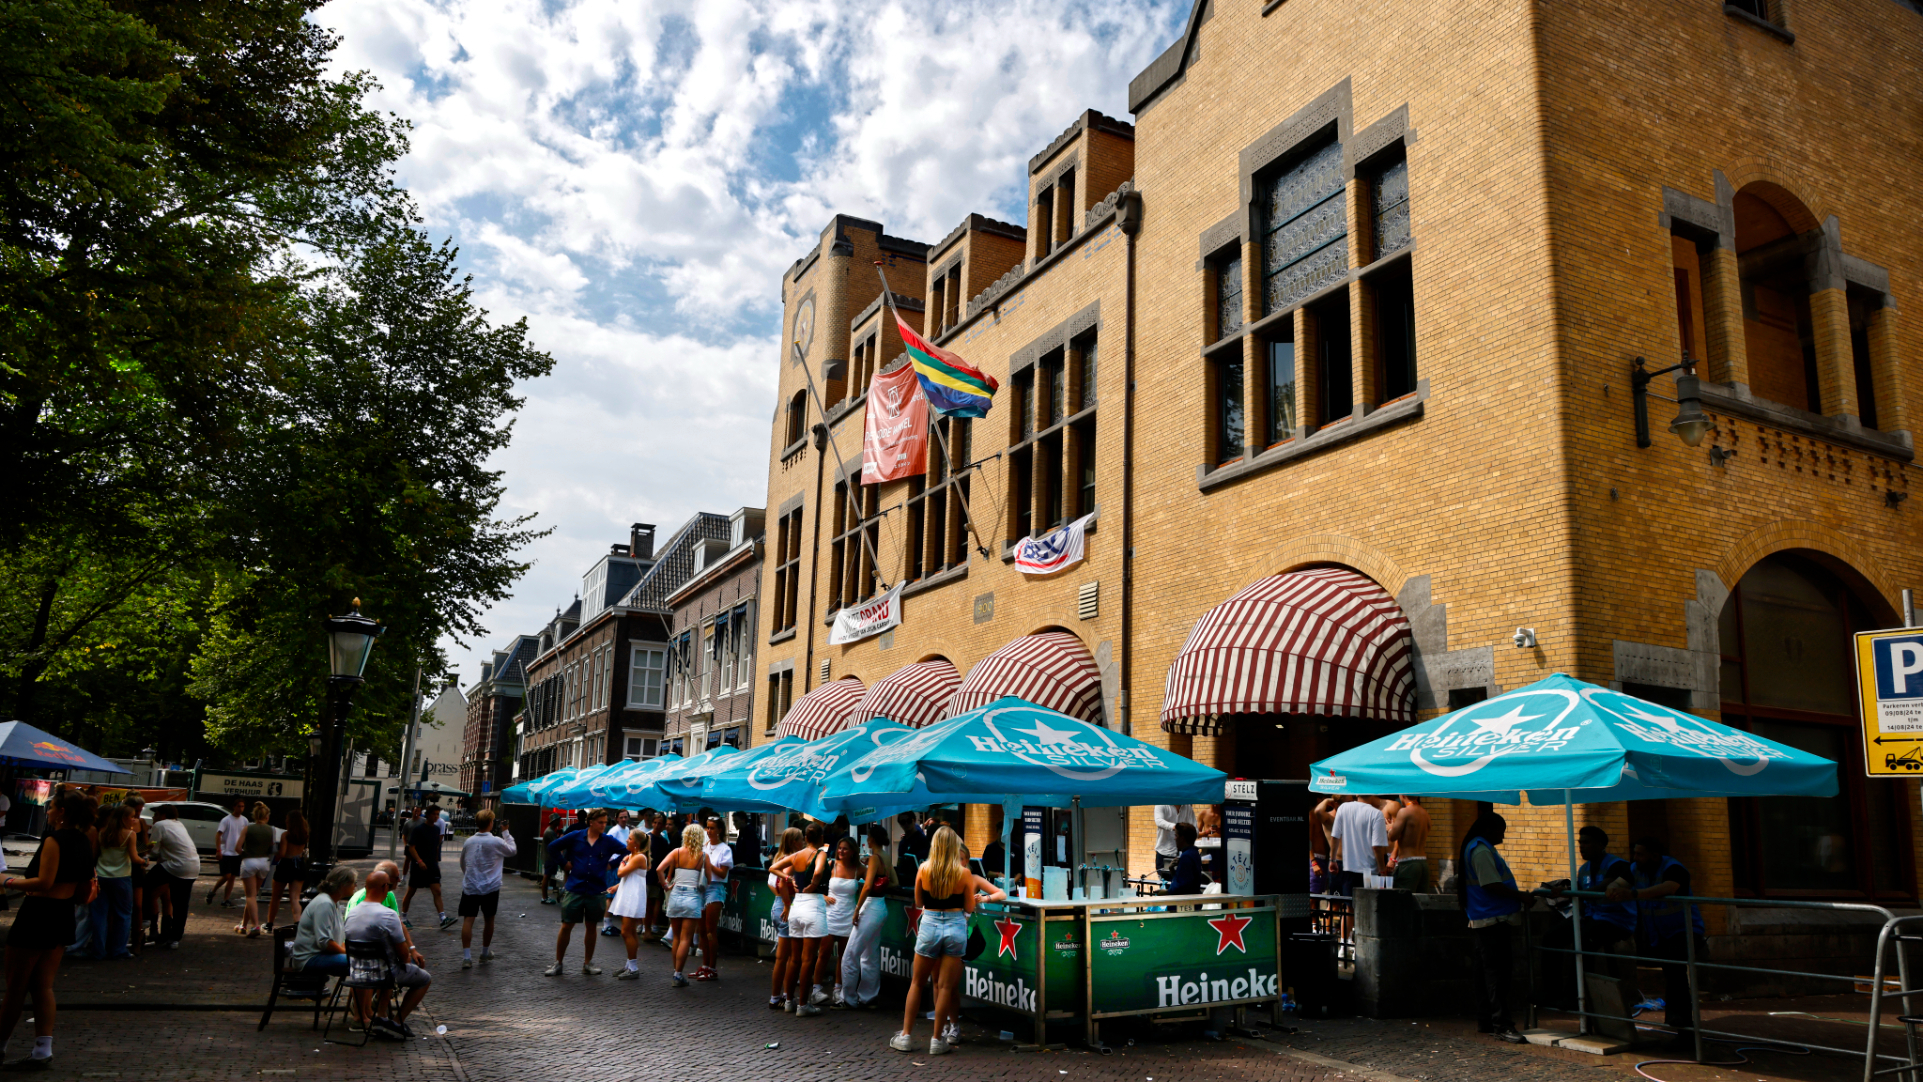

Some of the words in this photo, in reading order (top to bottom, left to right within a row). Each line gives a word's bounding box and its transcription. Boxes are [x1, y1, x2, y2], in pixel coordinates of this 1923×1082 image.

[1890, 642, 1923, 694] P
[1384, 726, 1580, 752] Heineken
[965, 735, 1158, 760] Heineken
[1432, 741, 1568, 758] SILVER
[33, 749, 62, 759] Red
[59, 752, 87, 763] Bull
[1046, 755, 1169, 769] SILVER
[239, 780, 263, 788] HAAS
[104, 793, 120, 803] BEN
[224, 788, 261, 796] VERHUUR
[1101, 939, 1129, 948] Heineken
